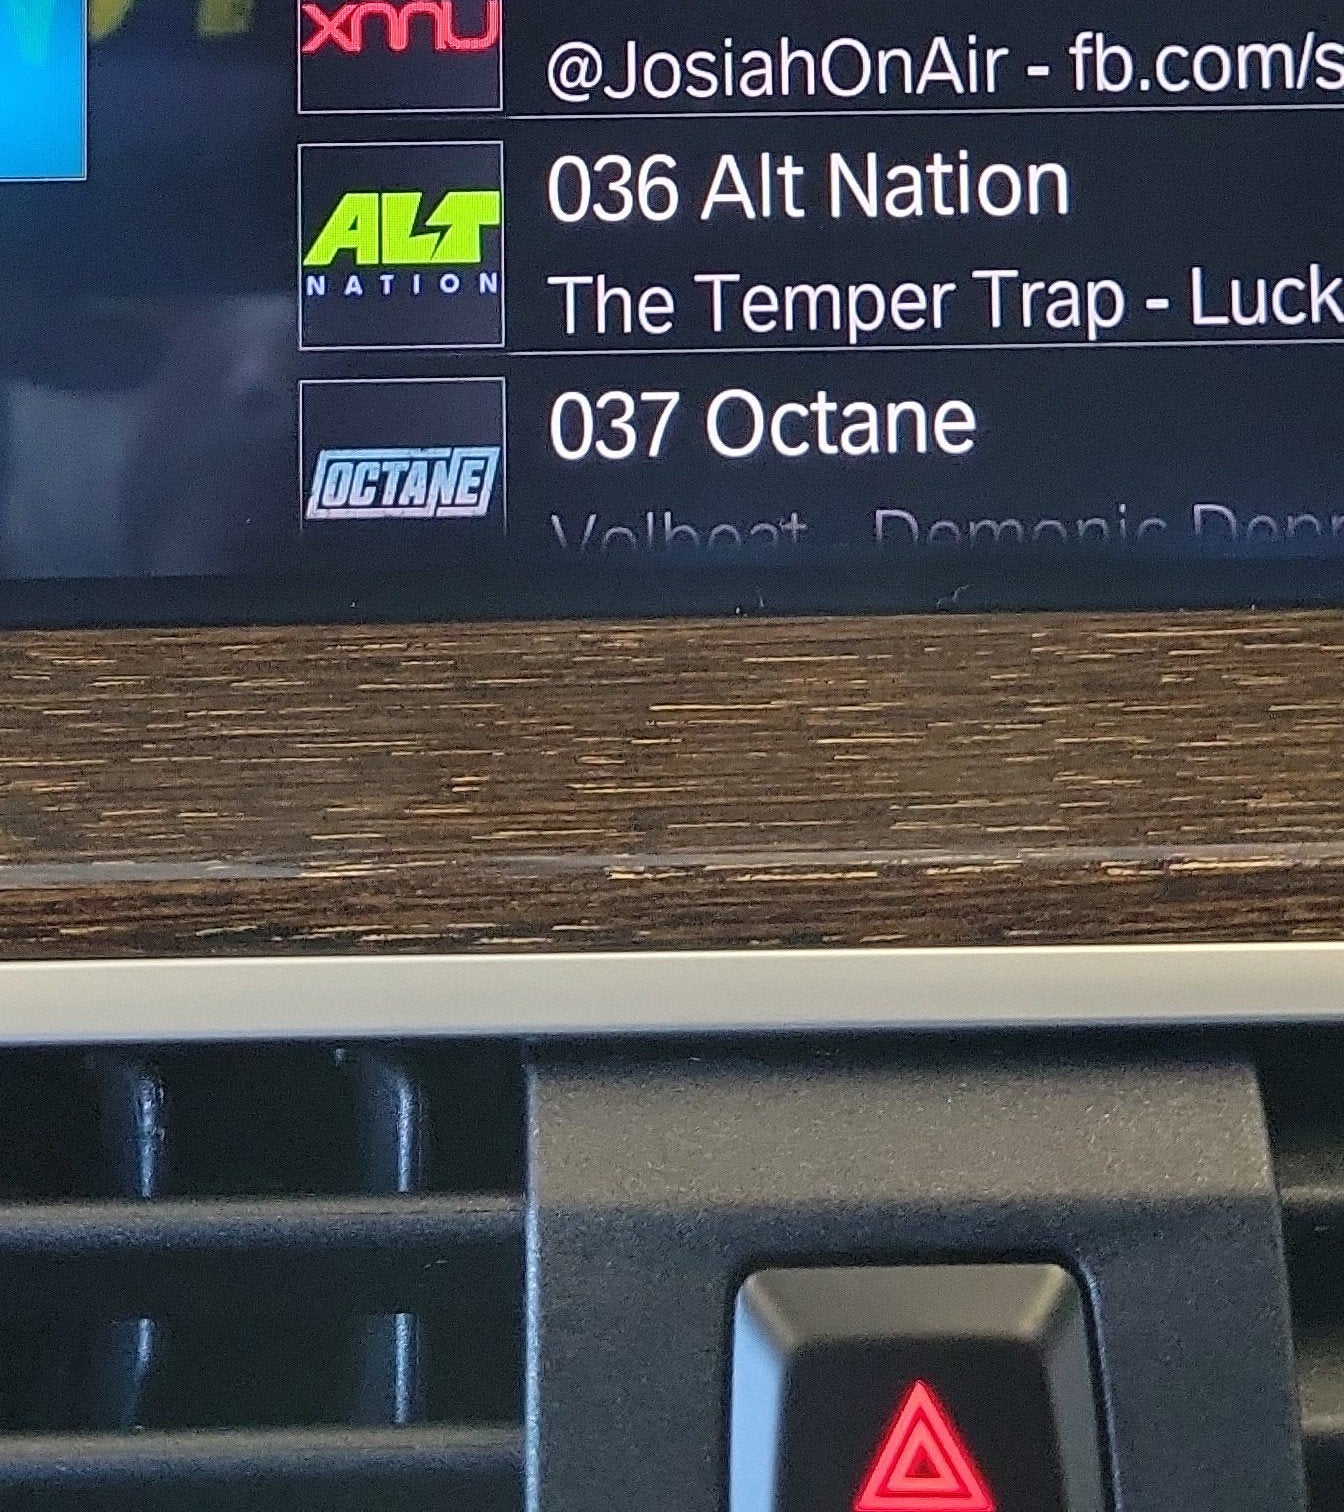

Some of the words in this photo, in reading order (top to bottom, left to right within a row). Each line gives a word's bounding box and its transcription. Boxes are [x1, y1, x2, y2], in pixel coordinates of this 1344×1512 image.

[546, 33, 1010, 104] @JosiahOnAir
[1026, 64, 1051, 77] -
[547, 152, 680, 224] 036
[699, 151, 806, 221] Alt
[829, 148, 1070, 219] Nation
[304, 191, 499, 265] ALT
[305, 271, 499, 297] NATION
[546, 273, 676, 335] The
[693, 272, 957, 346] Temper
[971, 268, 1126, 342] Trap
[1145, 297, 1170, 310] -
[549, 389, 681, 462] 037
[705, 387, 978, 459] Octane
[322, 459, 485, 506] OCTANE
